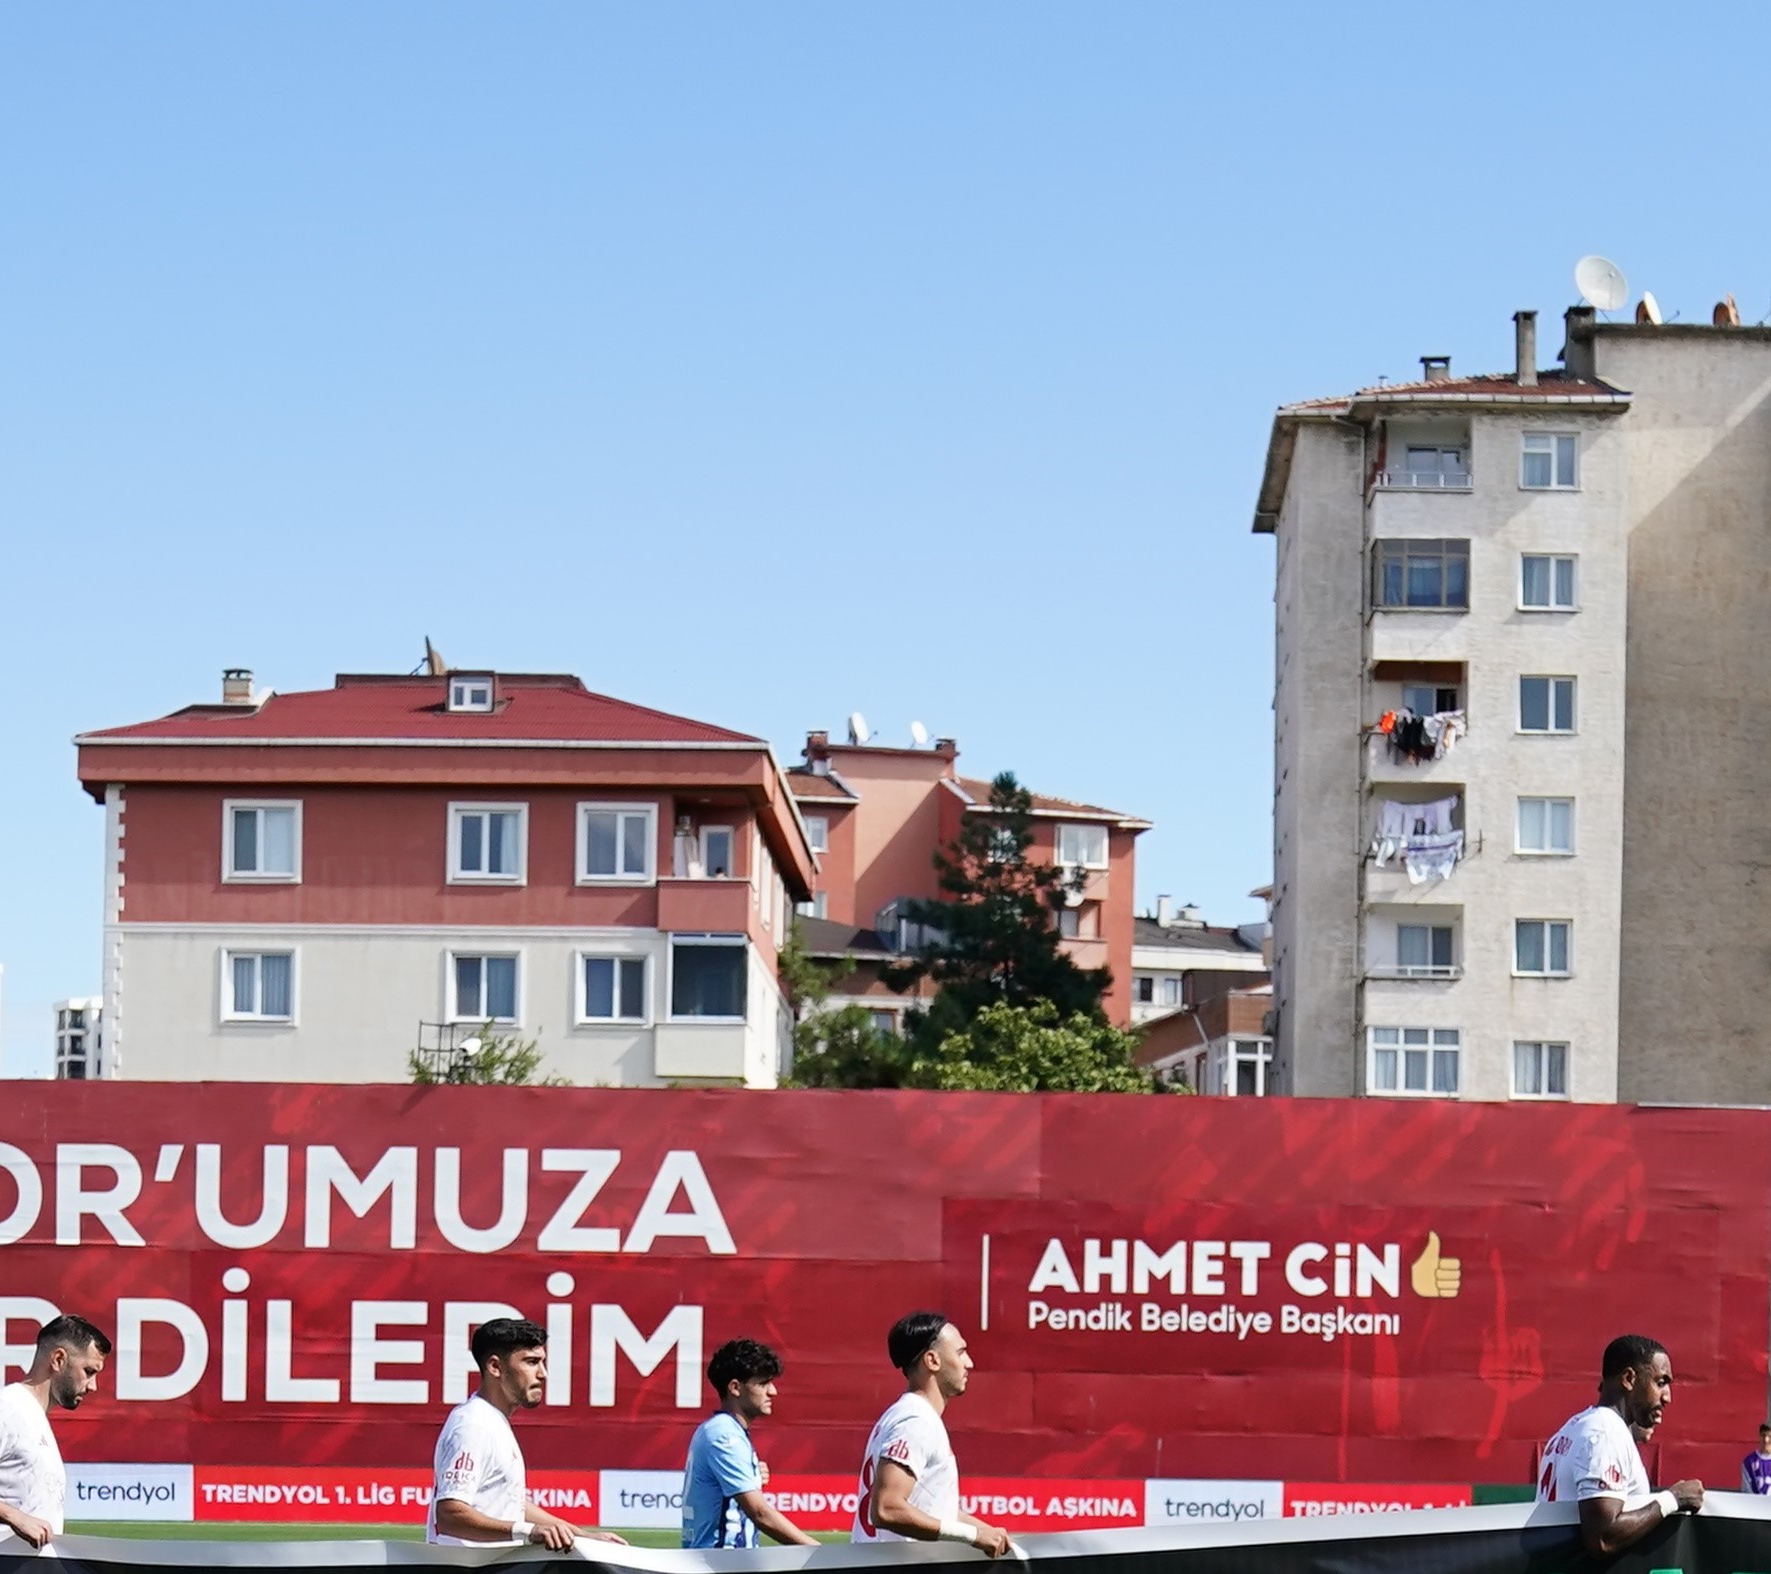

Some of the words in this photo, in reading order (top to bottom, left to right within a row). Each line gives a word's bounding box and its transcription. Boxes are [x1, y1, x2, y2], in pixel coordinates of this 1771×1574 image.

[1027, 1237, 1271, 1297] AHMET
[1027, 1300, 1133, 1332] Pendik
[1140, 1302, 1273, 1341] Belediye
[1280, 1304, 1401, 1343] Başkanı
[76, 1481, 176, 1507] trendyol
[201, 1483, 331, 1505] TRENDYOL
[334, 1485, 351, 1504] 1.
[356, 1482, 395, 1506] LİG
[1044, 1496, 1137, 1521] AŞKINA
[1165, 1496, 1264, 1522] trendyol
